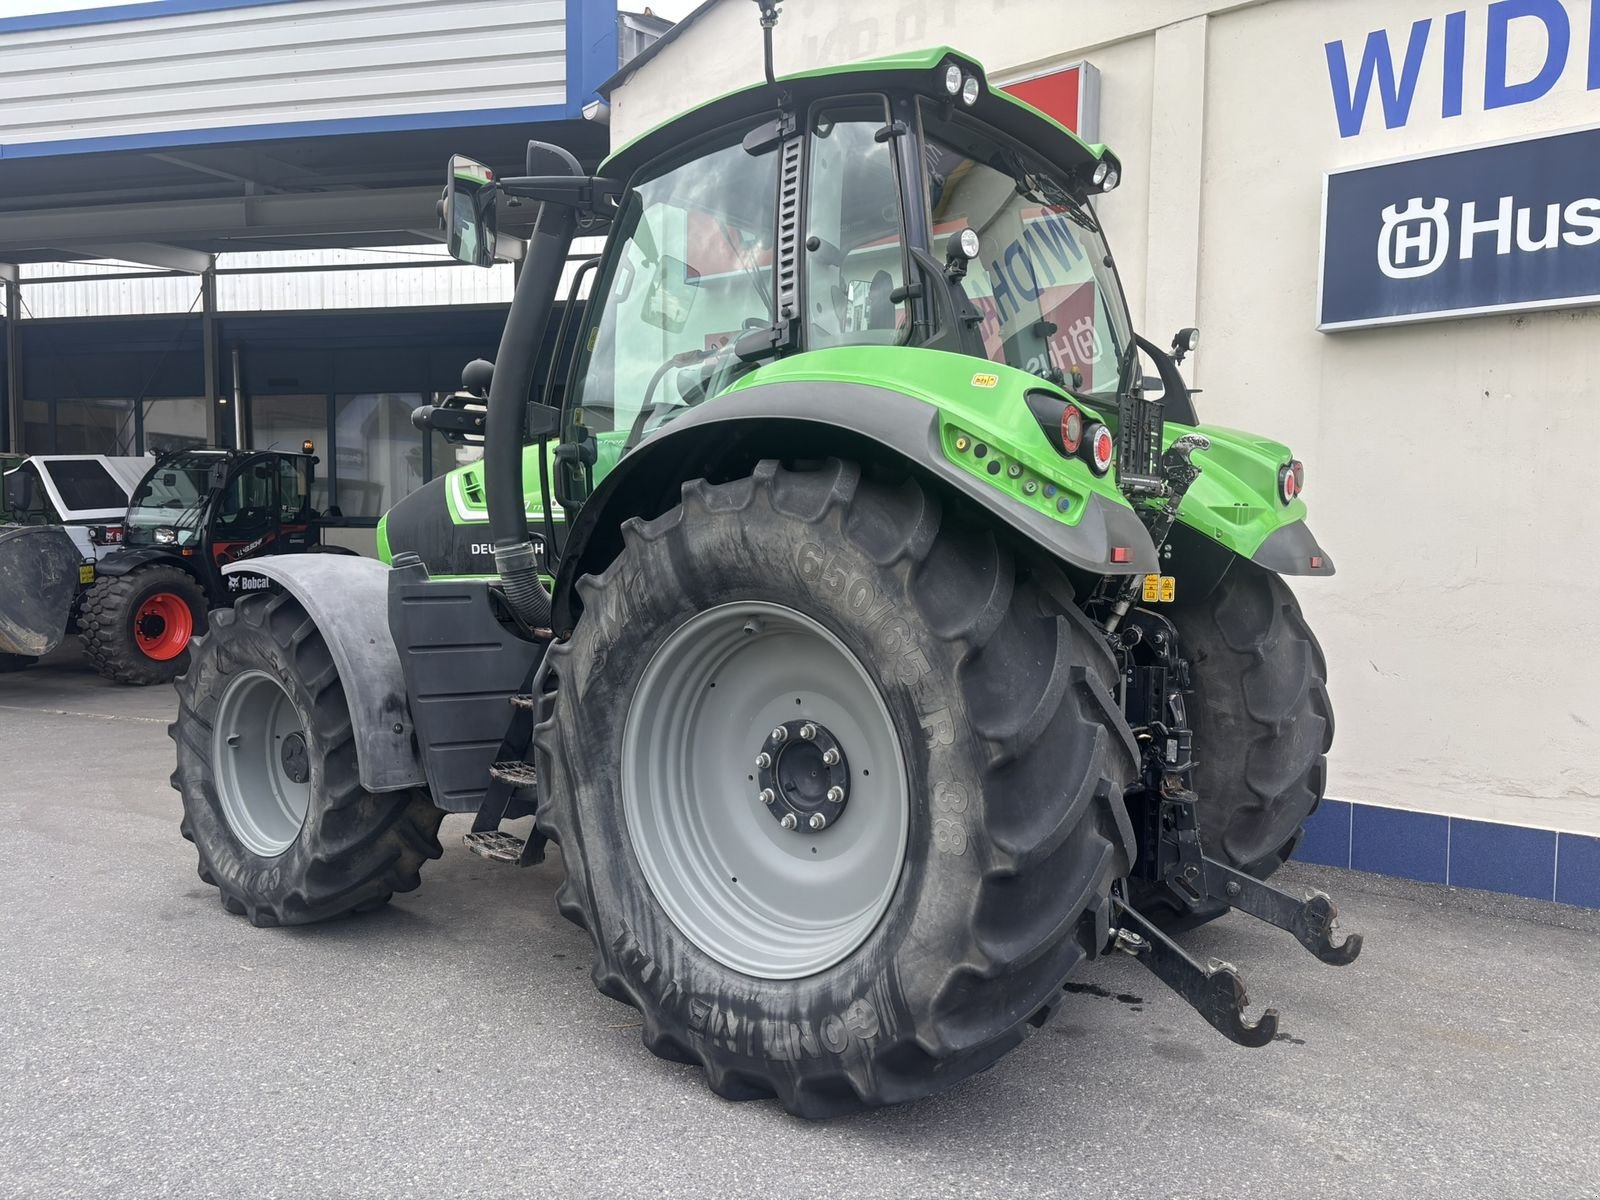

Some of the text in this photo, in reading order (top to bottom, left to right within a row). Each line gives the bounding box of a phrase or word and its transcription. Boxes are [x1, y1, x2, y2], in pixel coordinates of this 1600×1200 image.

[1458, 195, 1600, 260] Hus
[241, 576, 270, 590] Bobcat
[931, 780, 970, 857] 38
